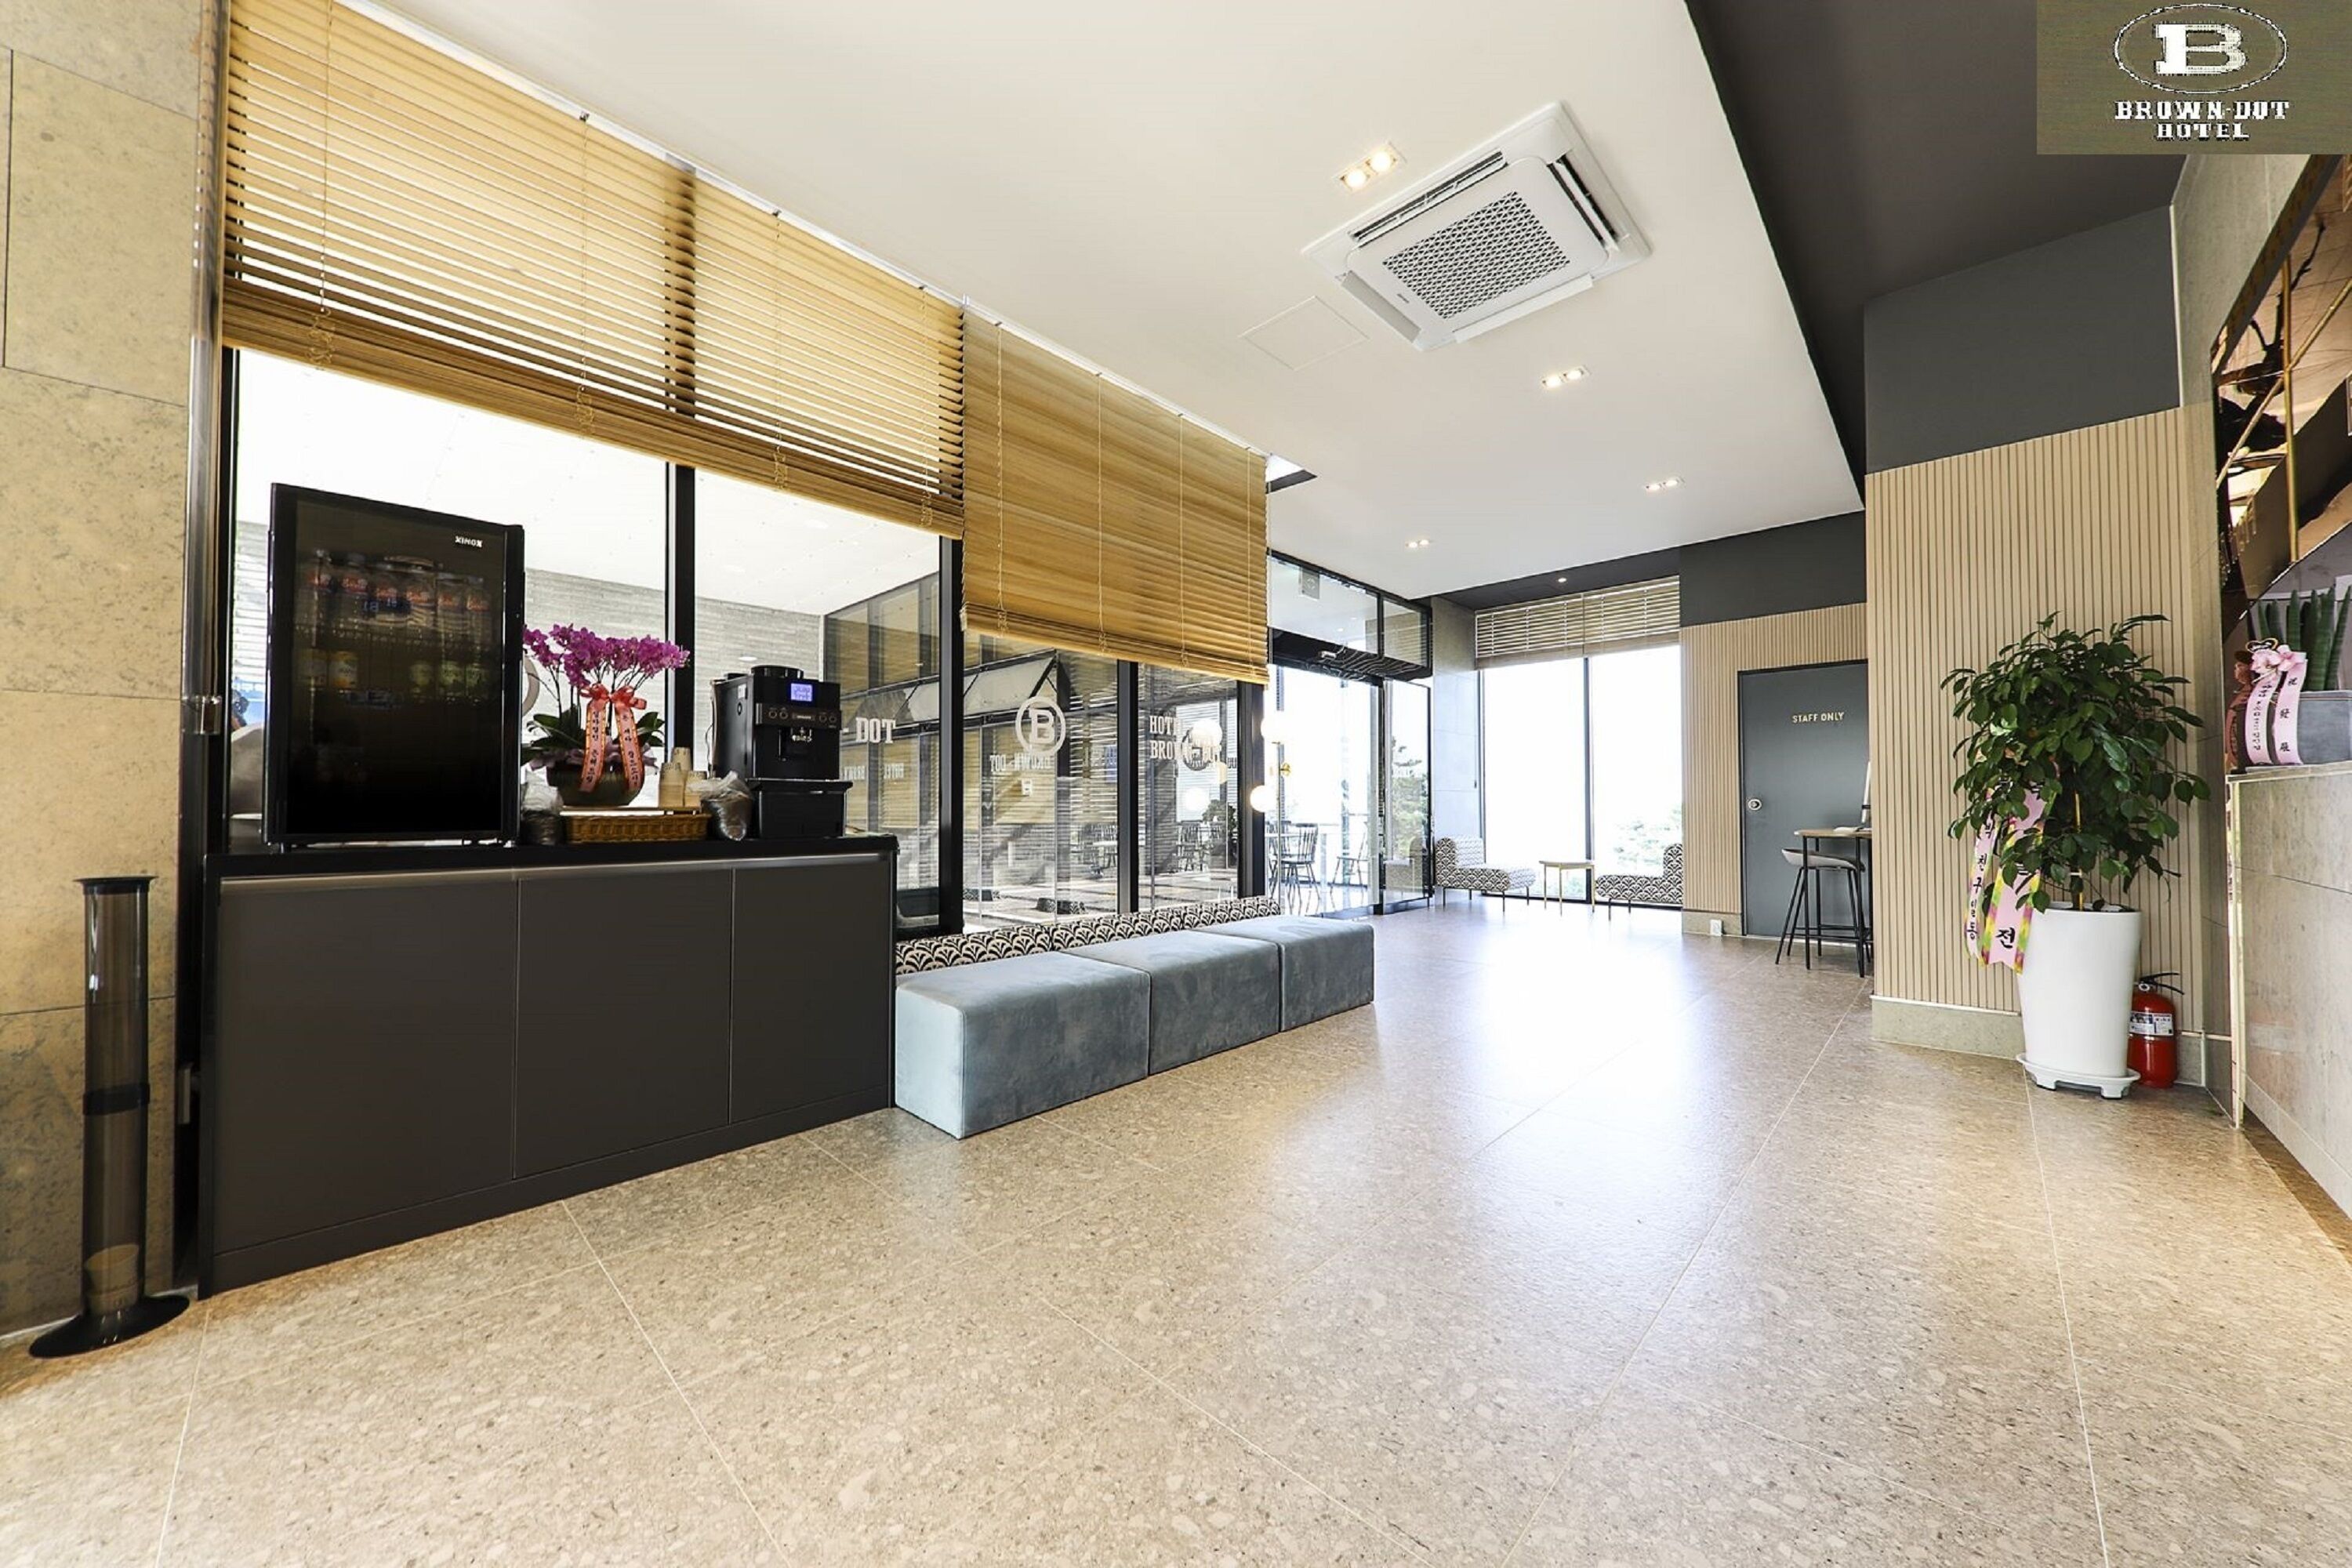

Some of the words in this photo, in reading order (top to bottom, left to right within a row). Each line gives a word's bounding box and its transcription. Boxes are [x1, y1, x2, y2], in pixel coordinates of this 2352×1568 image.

[1792, 713, 1818, 724] STAFF
[1821, 711, 1845, 722] ONLY
[855, 717, 896, 743] DOT
